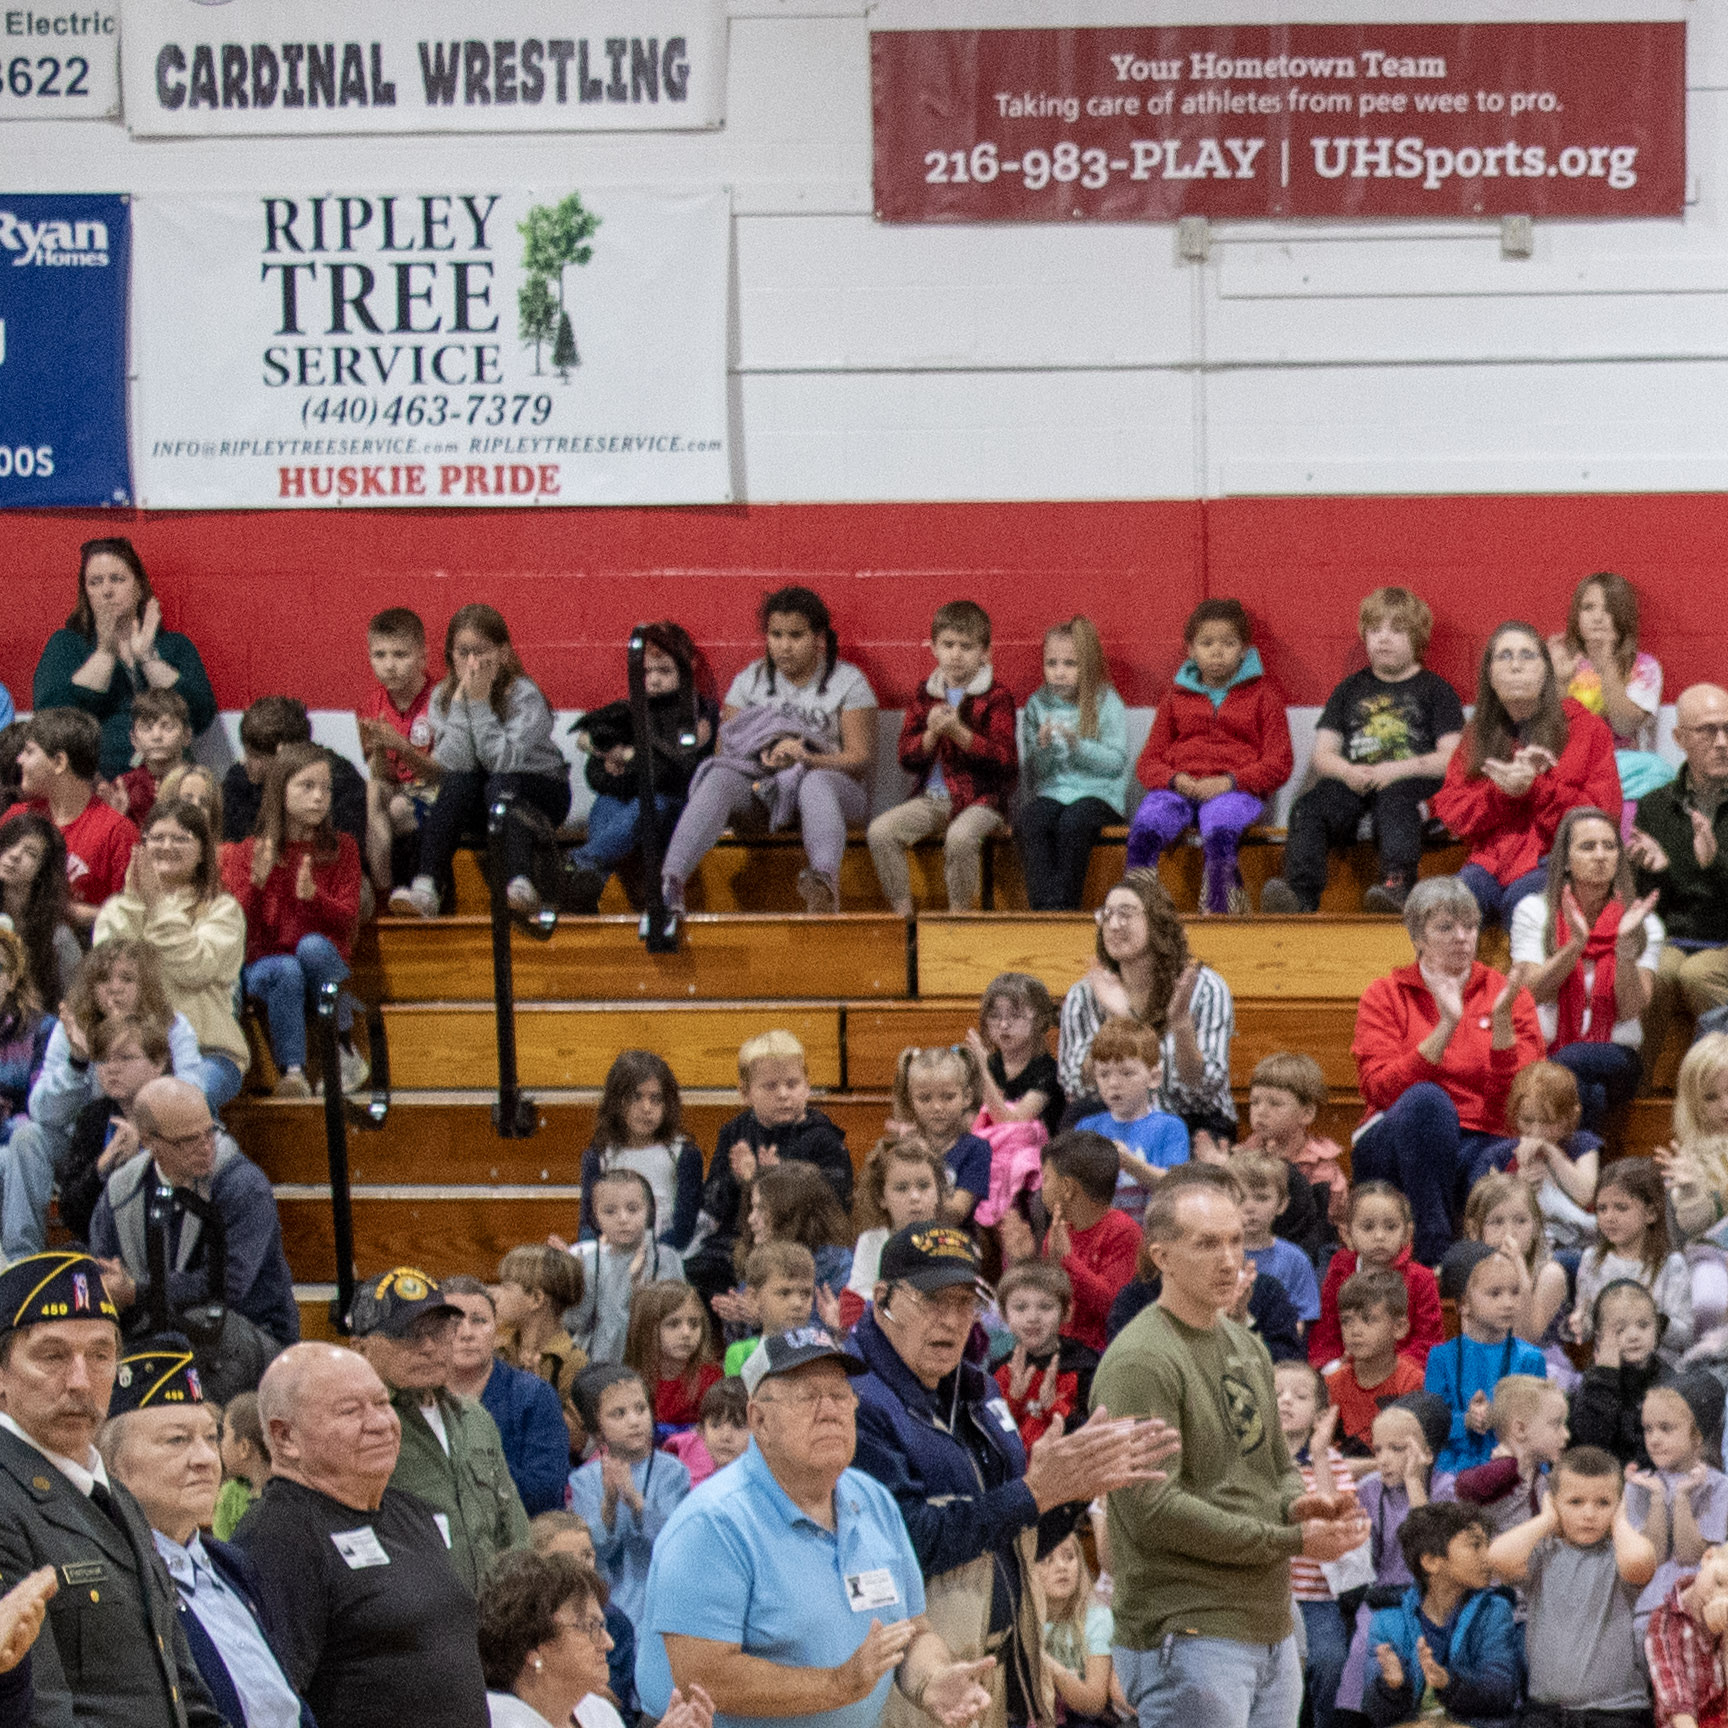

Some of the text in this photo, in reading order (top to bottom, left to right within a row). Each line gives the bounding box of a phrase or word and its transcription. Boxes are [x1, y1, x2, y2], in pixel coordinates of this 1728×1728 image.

[5, 11, 115, 36] Electric
[0, 56, 89, 97] 622
[155, 37, 692, 111] CARDINAL WRESTLING
[1112, 52, 1446, 82] Your Hometown Team
[994, 88, 1563, 123] Taking care of athletes from pee wee to pro.
[923, 138, 1639, 191] 216-983-PLAY UHSports.org
[261, 192, 503, 254] RIPLEY
[35, 249, 110, 267] Homes
[260, 261, 502, 337] TREE
[261, 344, 504, 389] SERVICE
[277, 463, 562, 498] HUSKIE PRIDE
